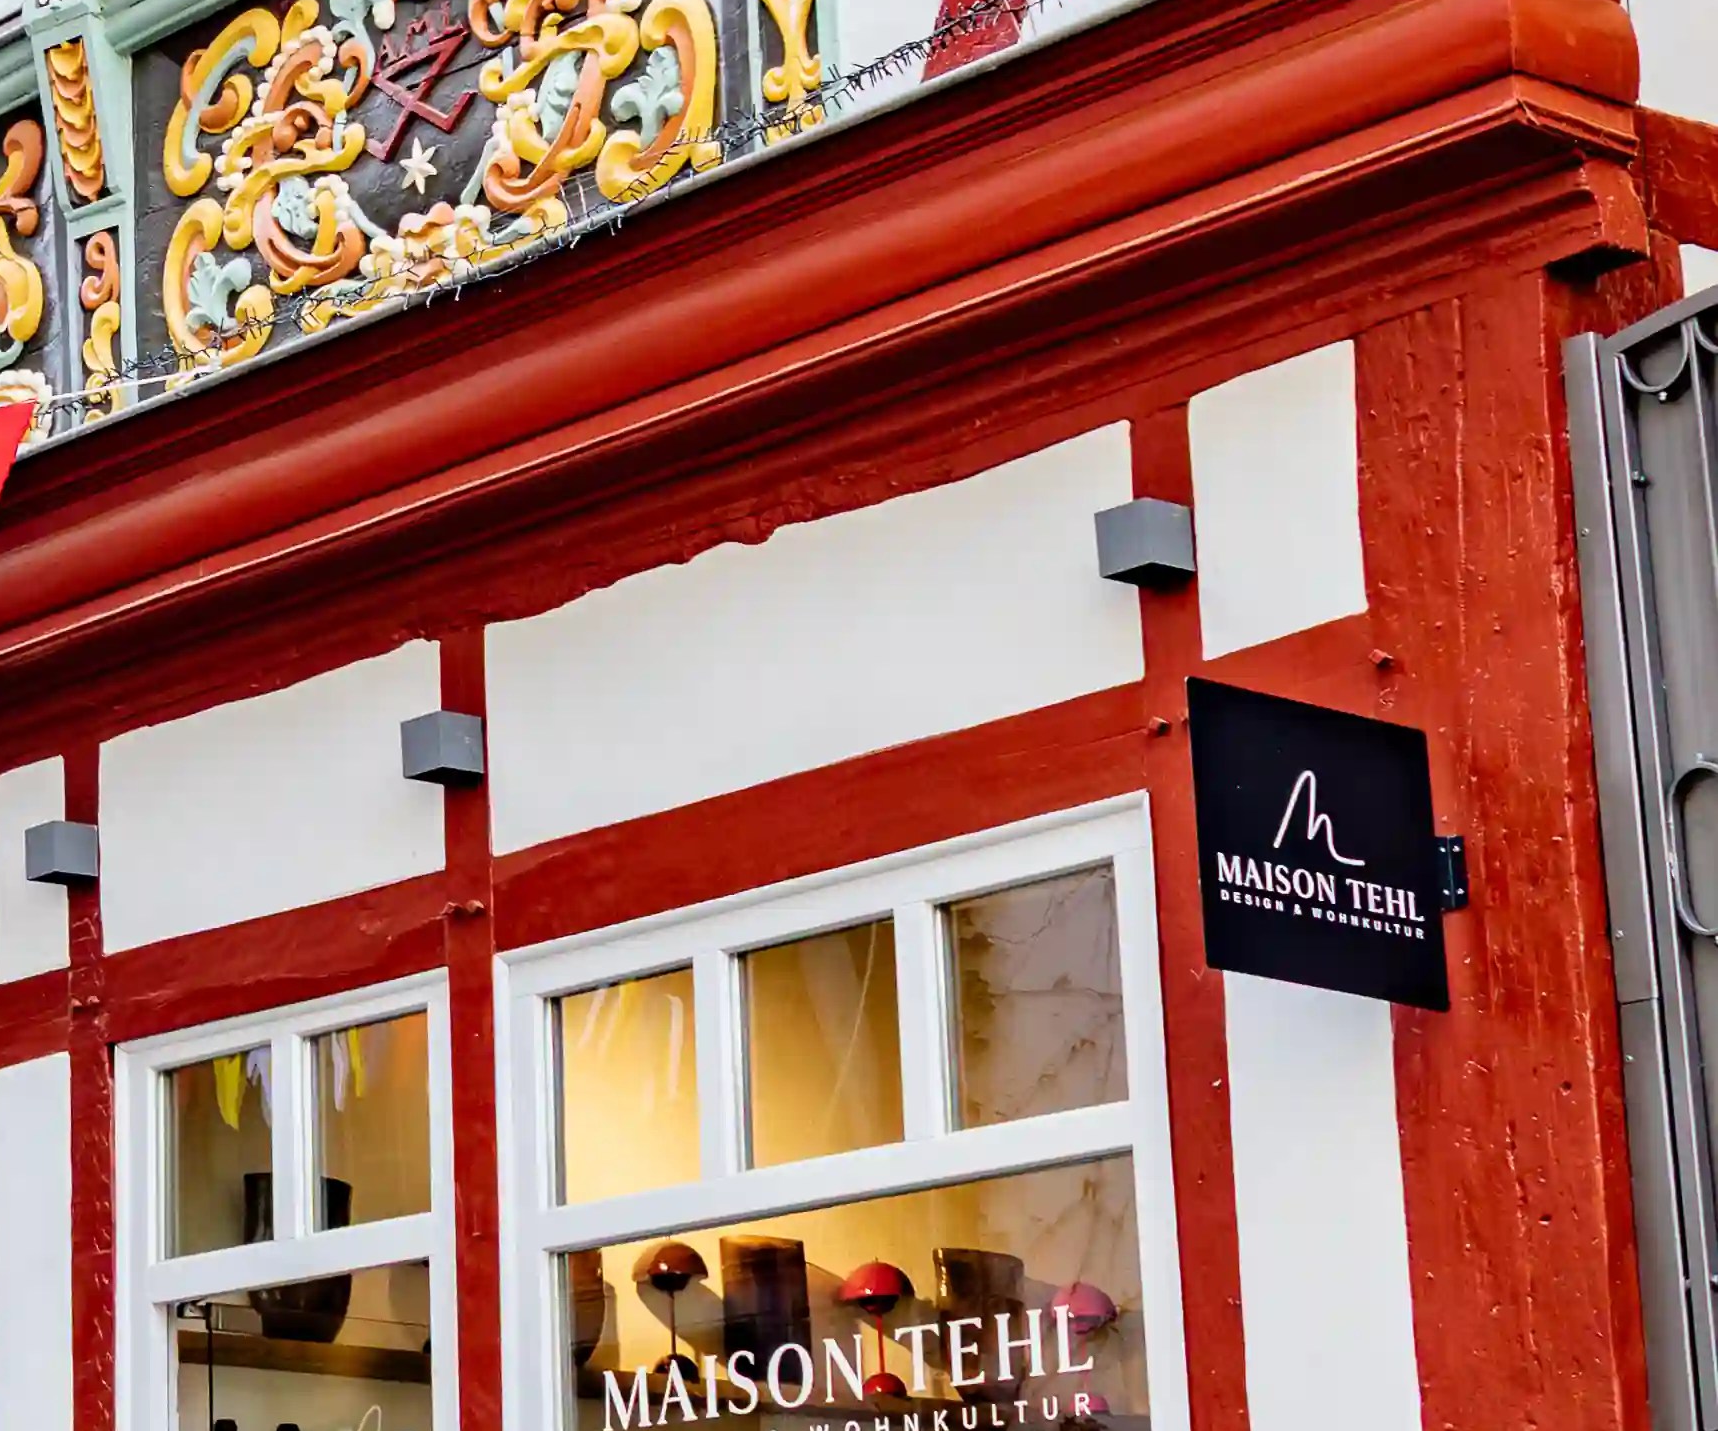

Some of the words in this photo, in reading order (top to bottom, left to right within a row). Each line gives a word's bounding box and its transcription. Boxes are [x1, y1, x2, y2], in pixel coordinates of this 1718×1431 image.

[1216, 851, 1337, 905] MAISON
[1345, 878, 1426, 922] TEHL
[1220, 889, 1285, 912] DESIGN
[1293, 903, 1303, 916] &
[1311, 907, 1426, 940] WOHNKULTUR
[602, 1334, 864, 1431] MAISON
[894, 1304, 1094, 1392] TEHL
